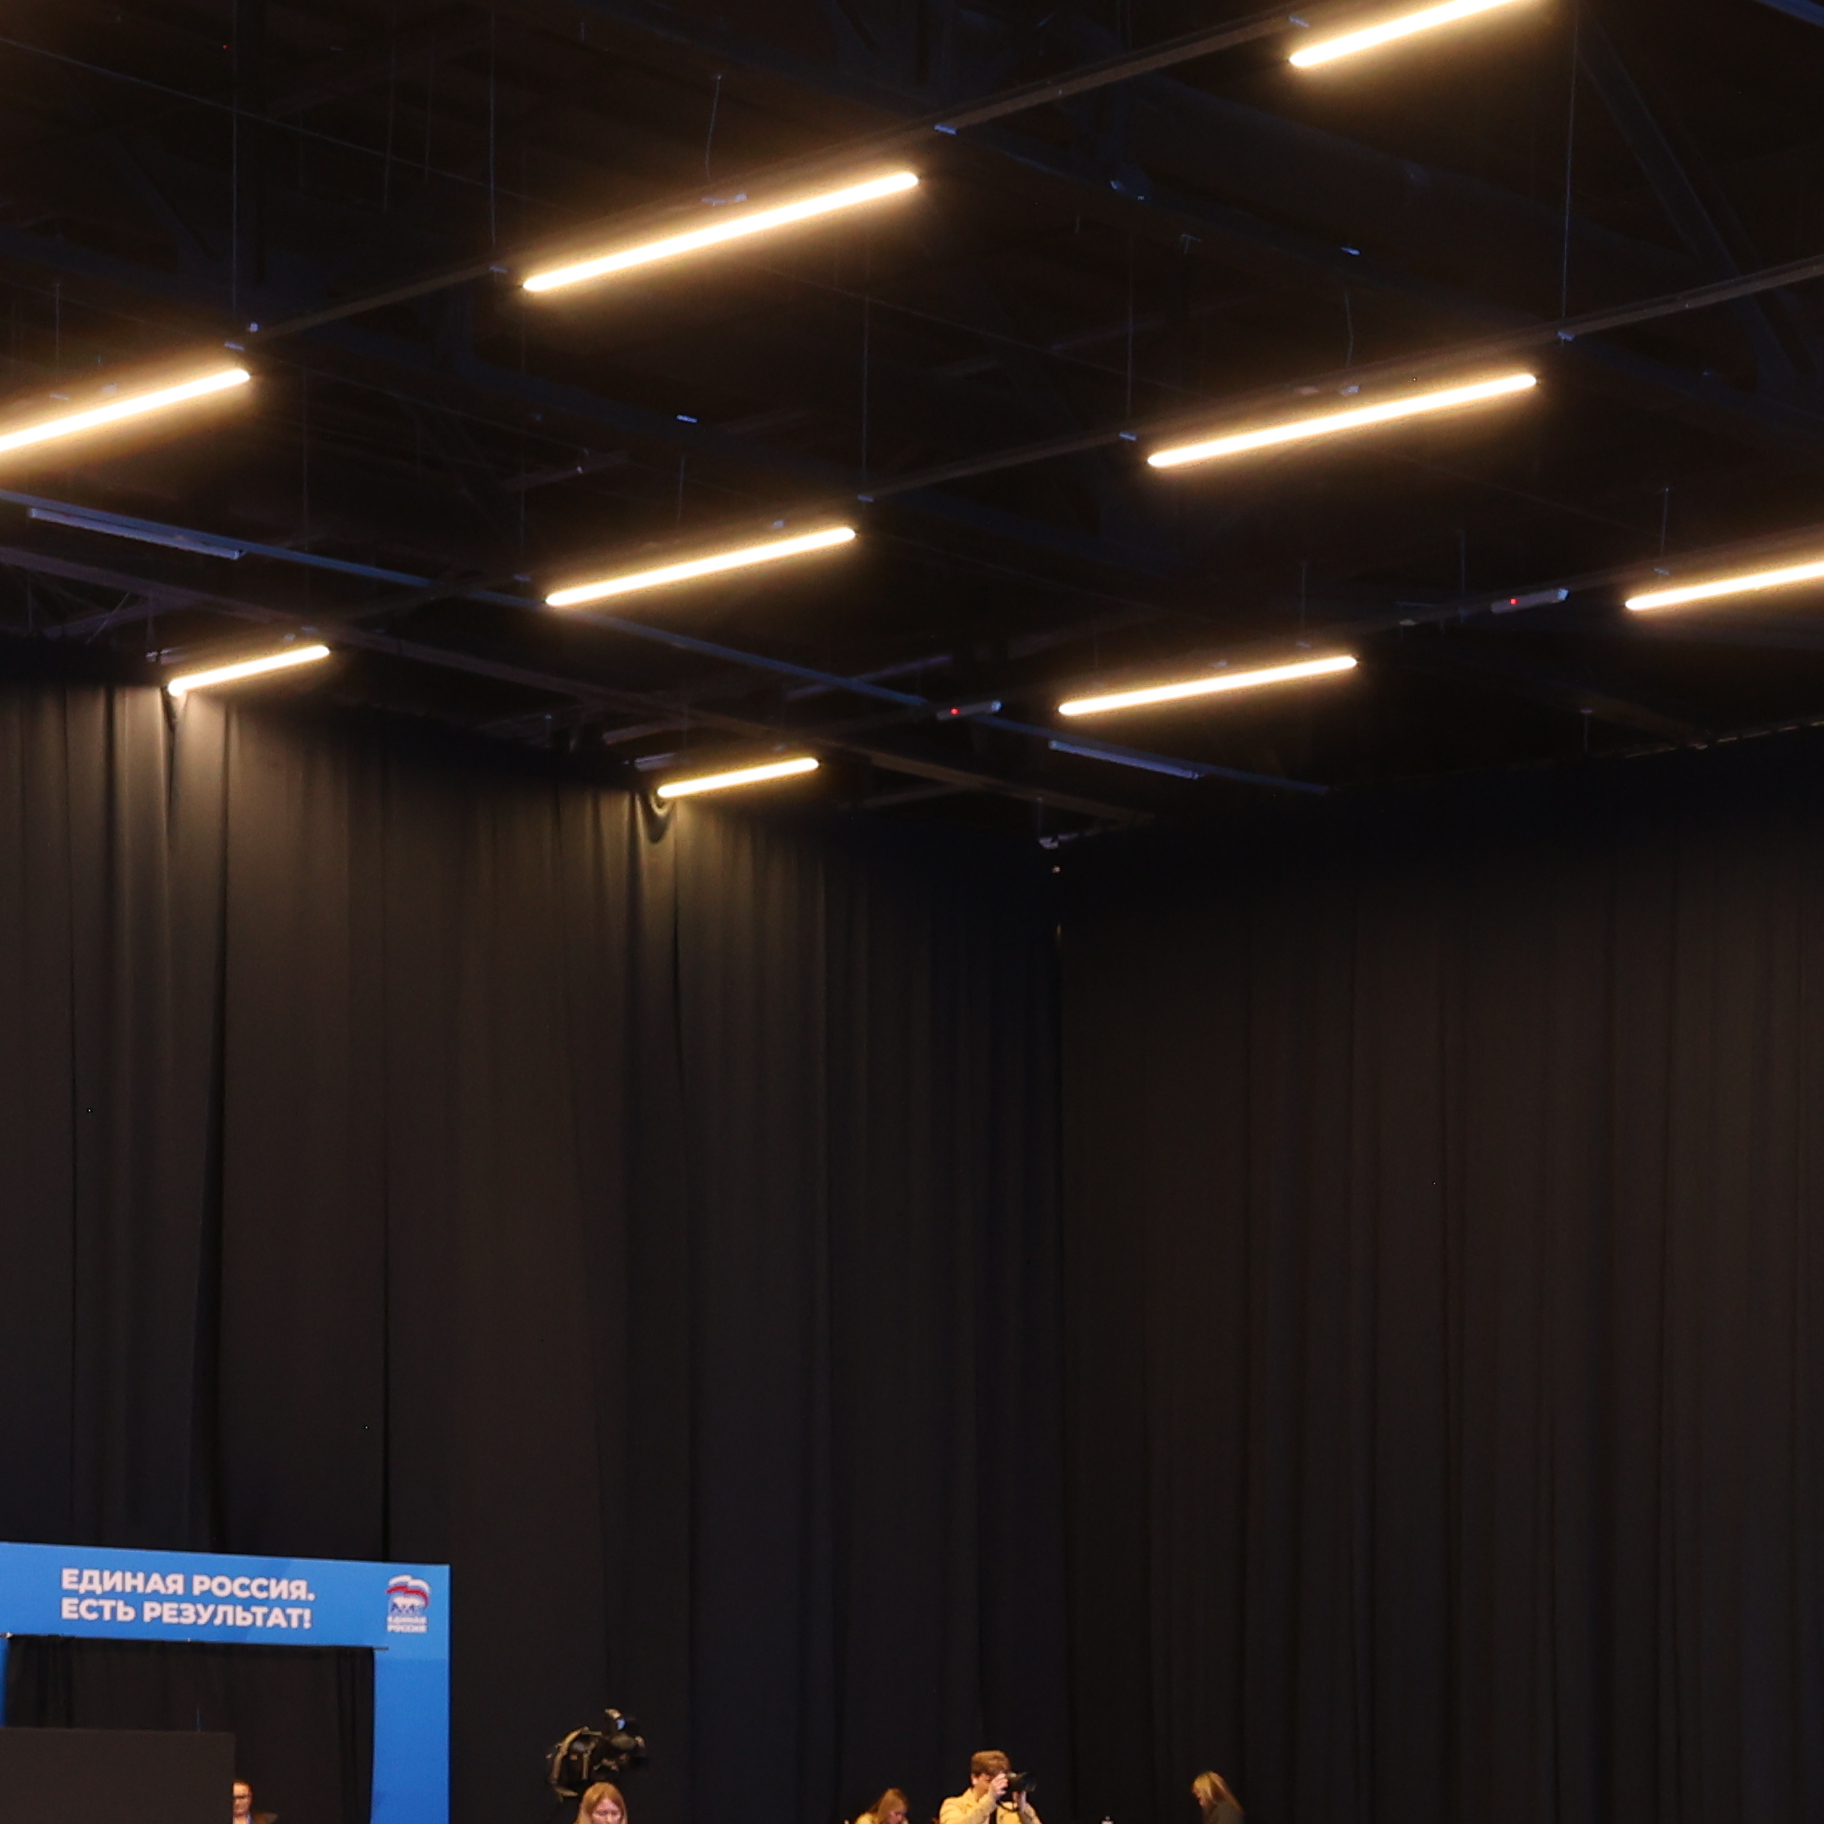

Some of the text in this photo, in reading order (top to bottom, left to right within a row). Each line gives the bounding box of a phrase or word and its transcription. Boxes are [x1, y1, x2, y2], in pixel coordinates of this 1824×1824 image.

[61, 1568, 316, 1601] ЕДИНАЯ РОССИЯ.
[61, 1598, 312, 1629] ЕСТЬ РЕЗУЛЬТАТ!
